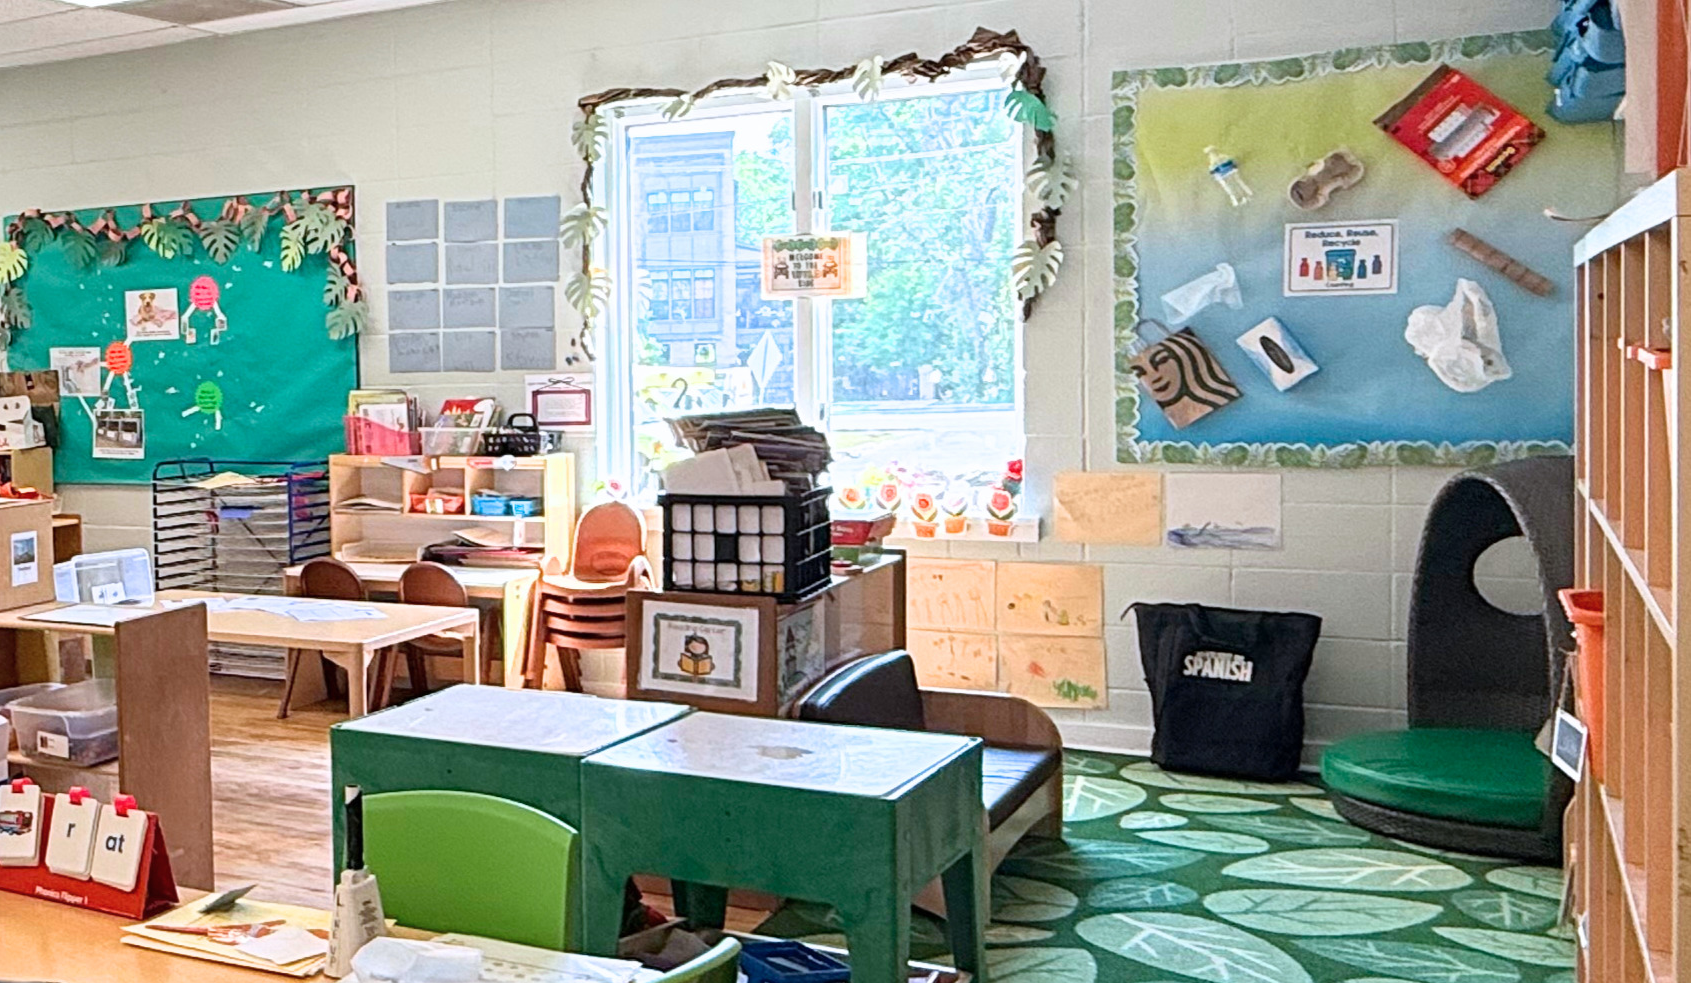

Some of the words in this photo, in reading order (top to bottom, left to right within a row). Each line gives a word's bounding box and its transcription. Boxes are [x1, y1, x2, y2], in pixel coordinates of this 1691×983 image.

[1183, 654, 1253, 682] SPANISH
[66, 822, 76, 838] r
[105, 833, 125, 853] at
